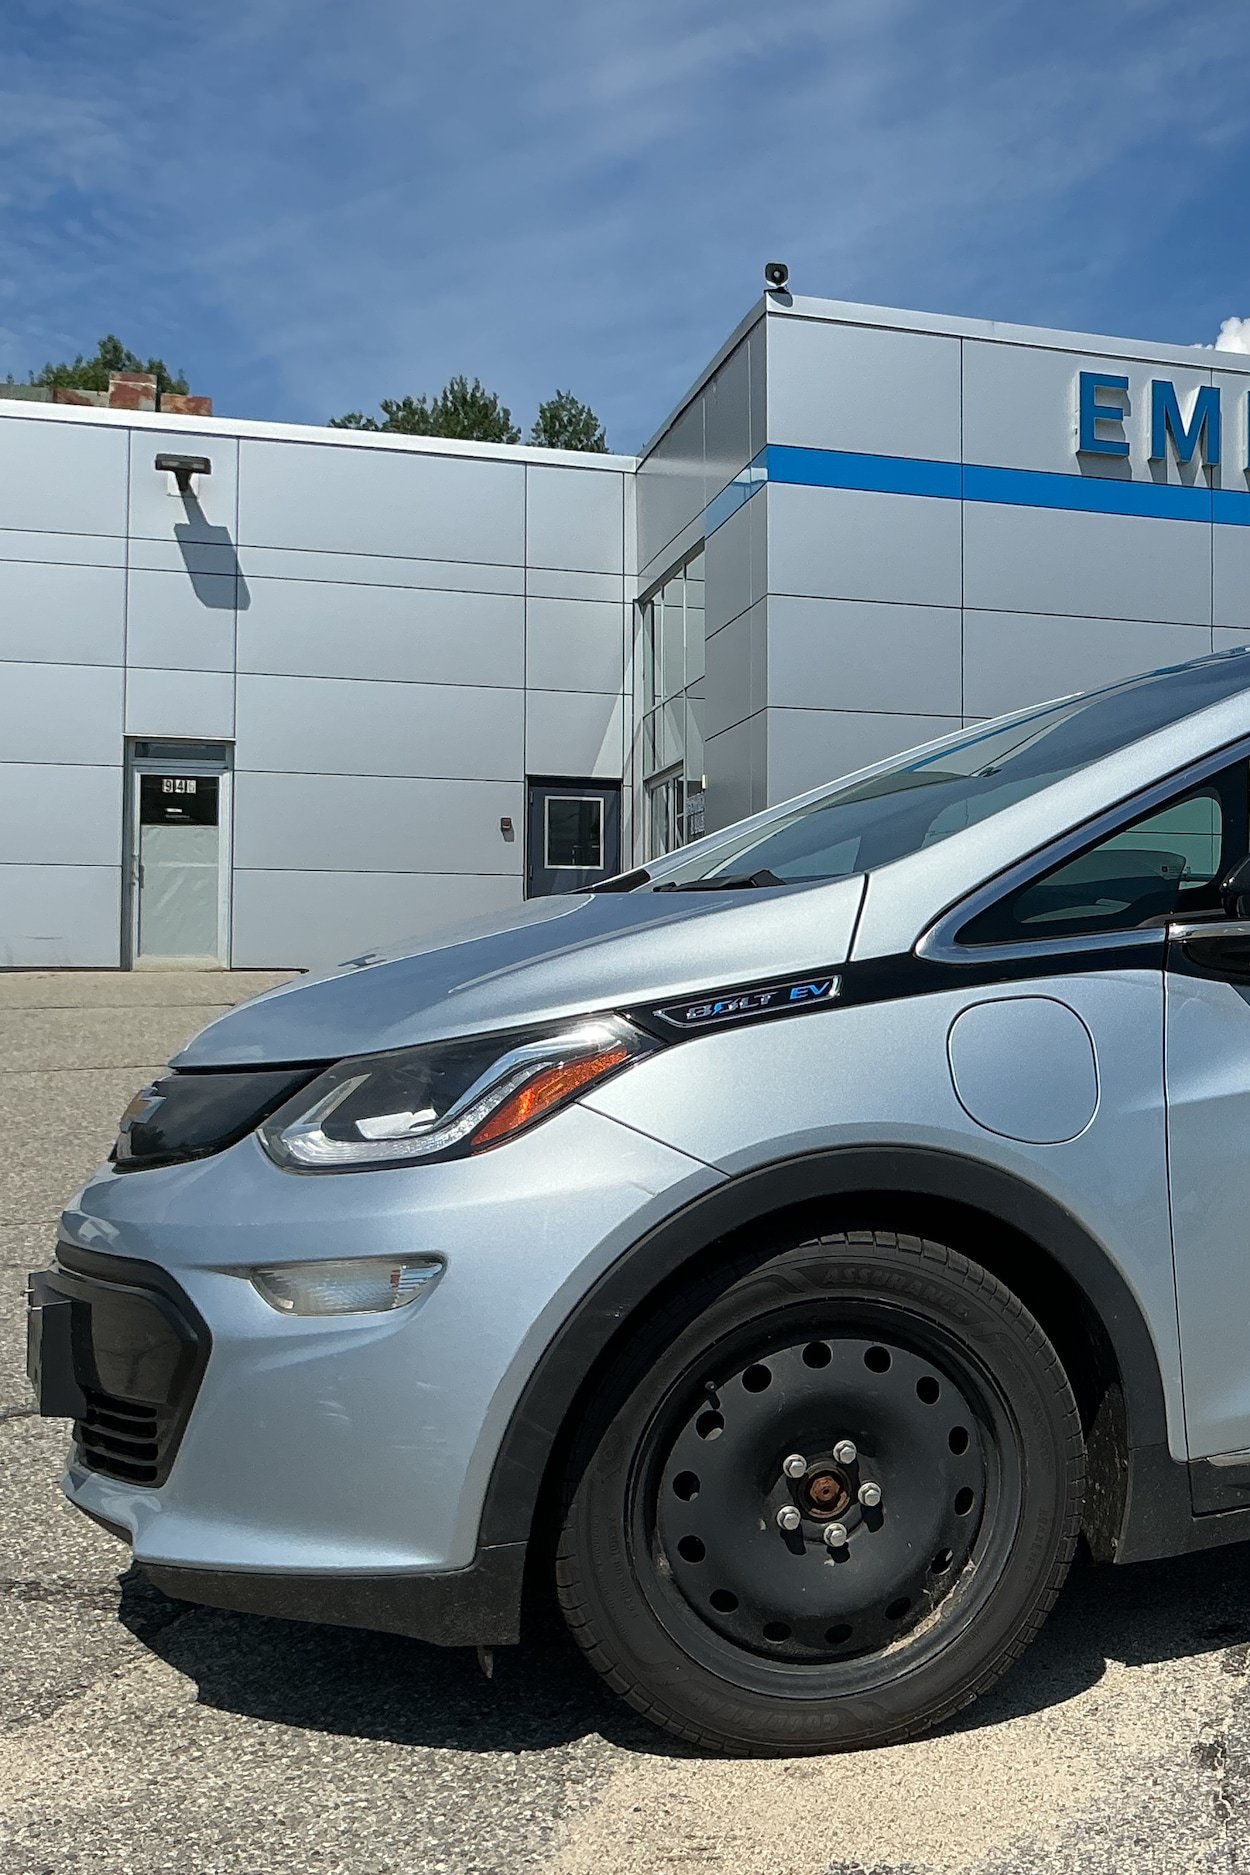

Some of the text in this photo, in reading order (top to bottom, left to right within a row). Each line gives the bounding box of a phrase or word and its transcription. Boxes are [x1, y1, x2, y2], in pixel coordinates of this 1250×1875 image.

[687, 981, 830, 1019] BOLT EV
[822, 1267, 971, 1319] ASSURANCE
[687, 1688, 840, 1731] GOODYEAR
